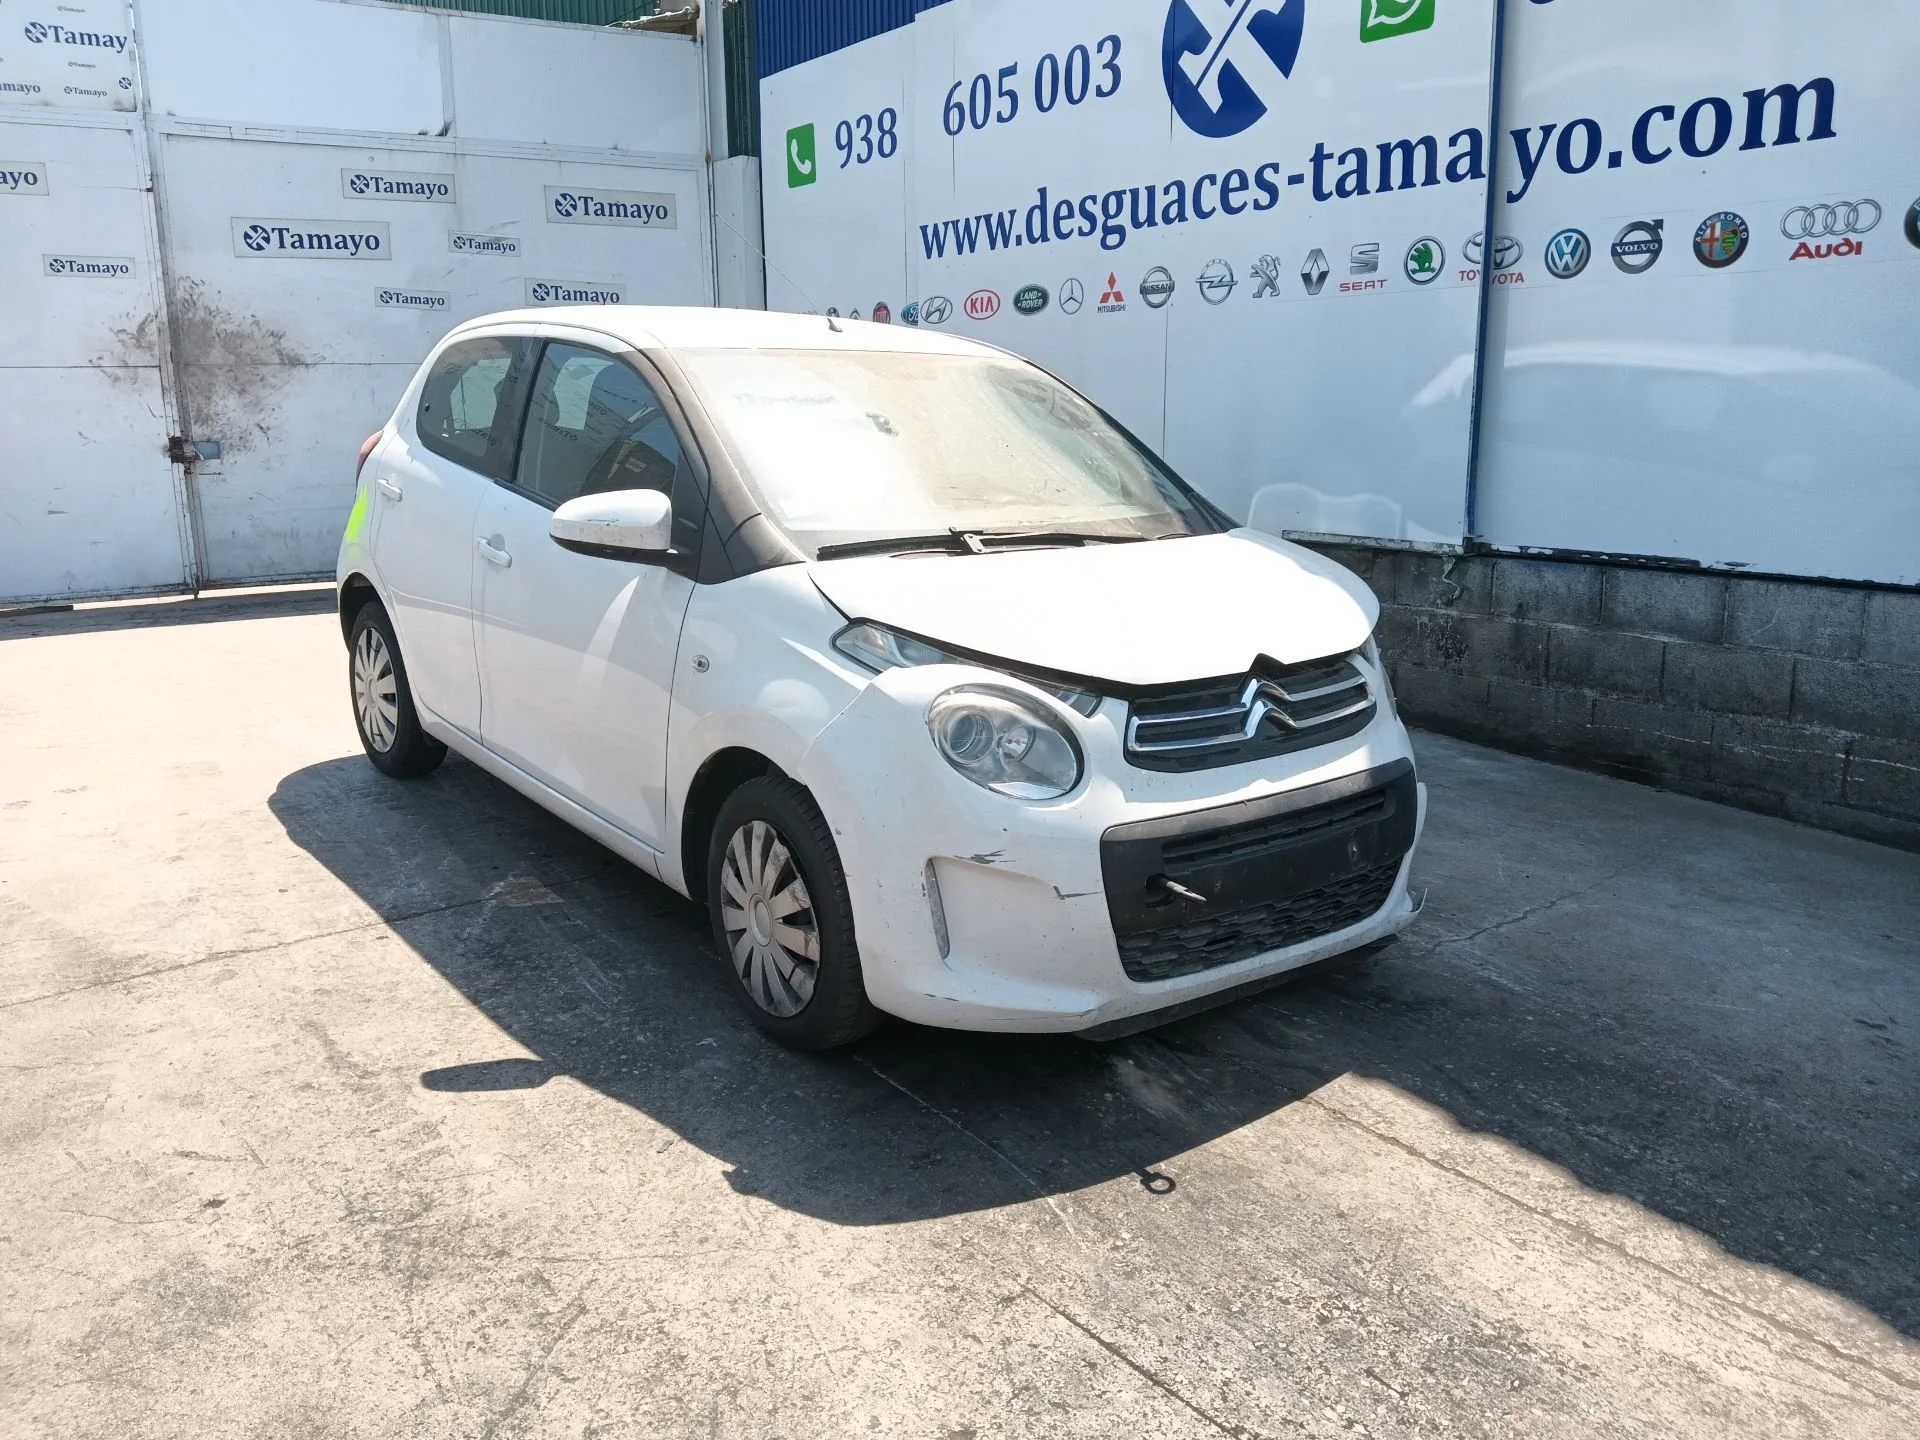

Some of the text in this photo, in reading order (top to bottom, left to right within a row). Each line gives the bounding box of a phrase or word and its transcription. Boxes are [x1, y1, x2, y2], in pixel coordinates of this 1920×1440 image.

[72, 87, 108, 98] Tamayo
[835, 34, 1122, 169] 938 605 003
[919, 77, 1837, 259] www.desguaces-tamayo.com
[370, 177, 449, 196] Tamayo
[578, 196, 668, 224] Tamayo
[271, 228, 380, 256] Tamayo
[466, 238, 516, 253] Tamayo
[1615, 242, 1659, 254] VOLVO
[1789, 238, 1862, 260] Audi
[66, 260, 129, 277] Tamayo
[1142, 283, 1171, 293] NISSAN
[1339, 279, 1388, 292] SEAT
[393, 292, 445, 308] Tamayo
[550, 285, 620, 305] Tamayo
[1020, 291, 1038, 300] LAND
[970, 297, 995, 314] KIA
[1021, 299, 1043, 309] ROVER
[1097, 304, 1126, 314] MITSUBISHI
